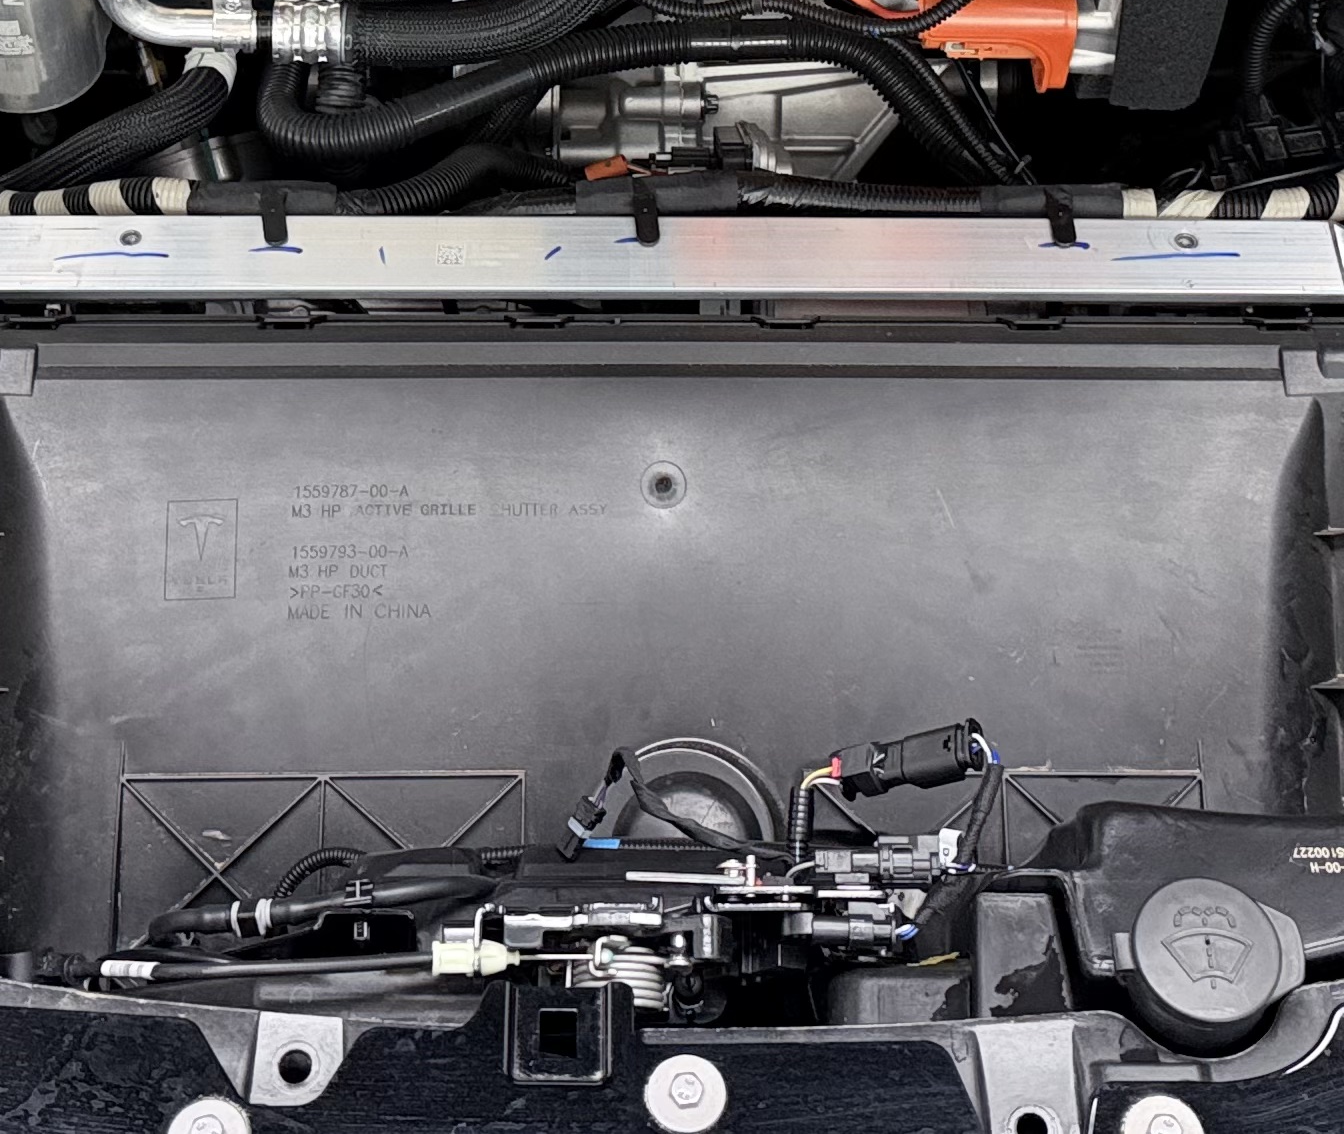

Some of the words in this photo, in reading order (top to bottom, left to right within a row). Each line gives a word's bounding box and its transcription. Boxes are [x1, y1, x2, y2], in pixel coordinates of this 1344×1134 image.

[294, 484, 409, 498] 1559787-00-A
[291, 504, 312, 518] M3
[321, 504, 341, 517] HP
[354, 503, 412, 516] ACTIVE
[420, 503, 476, 516] GRILLE
[568, 503, 607, 516] ASSY
[292, 545, 409, 559] 1559793-00-A
[288, 565, 309, 578] M3
[318, 564, 339, 578] HP
[349, 564, 388, 578] DUCT
[287, 605, 330, 619] MADE
[344, 604, 363, 618] IN
[373, 603, 432, 618] CHINA
